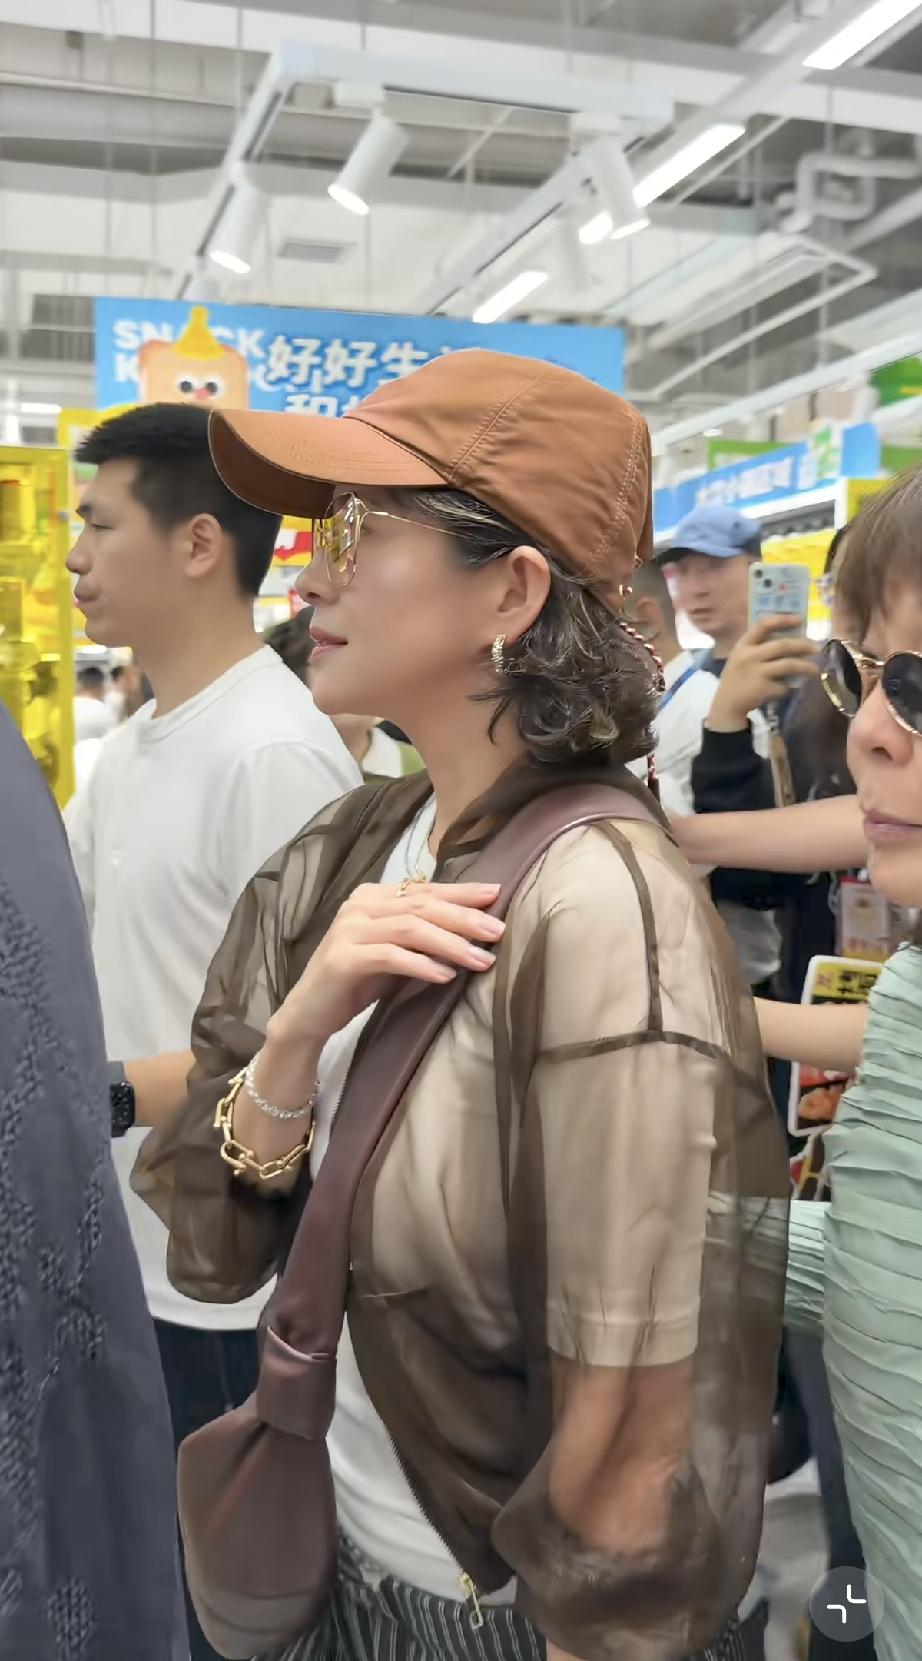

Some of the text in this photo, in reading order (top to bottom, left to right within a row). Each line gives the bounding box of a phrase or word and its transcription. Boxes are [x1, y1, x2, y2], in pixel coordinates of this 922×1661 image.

[113, 320, 264, 357] SNK
[268, 334, 458, 388] 好好生
